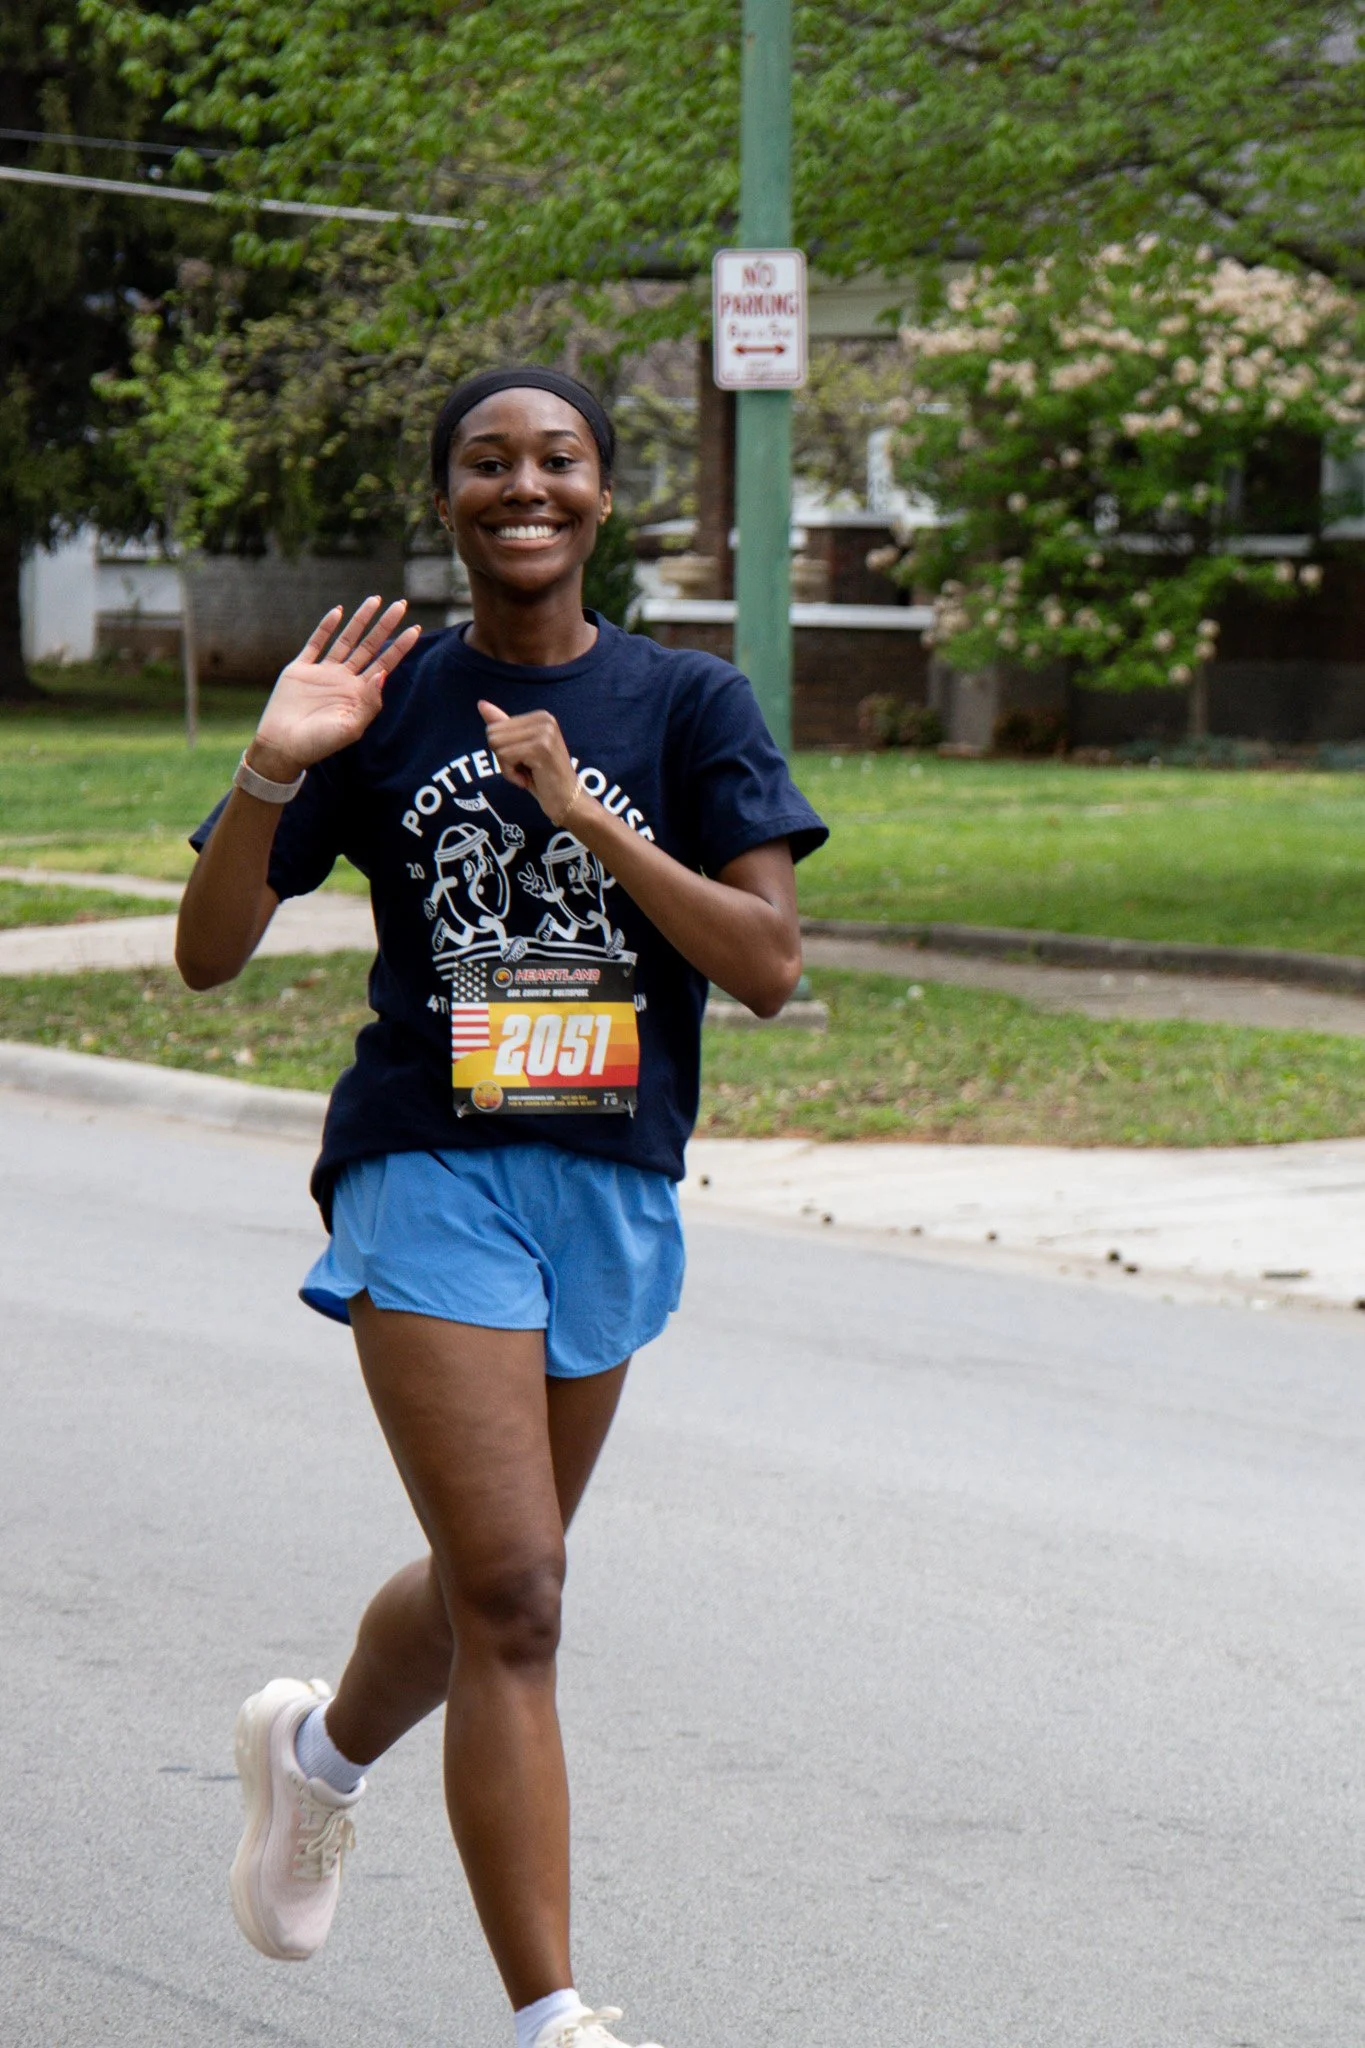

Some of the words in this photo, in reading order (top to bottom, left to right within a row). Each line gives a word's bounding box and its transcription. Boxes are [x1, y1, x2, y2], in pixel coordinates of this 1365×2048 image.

[742, 263, 775, 288] NO
[720, 293, 799, 317] PARKING
[405, 862, 425, 880] 20
[514, 968, 601, 982] HEARTLAND
[494, 1015, 612, 1076] 2051
